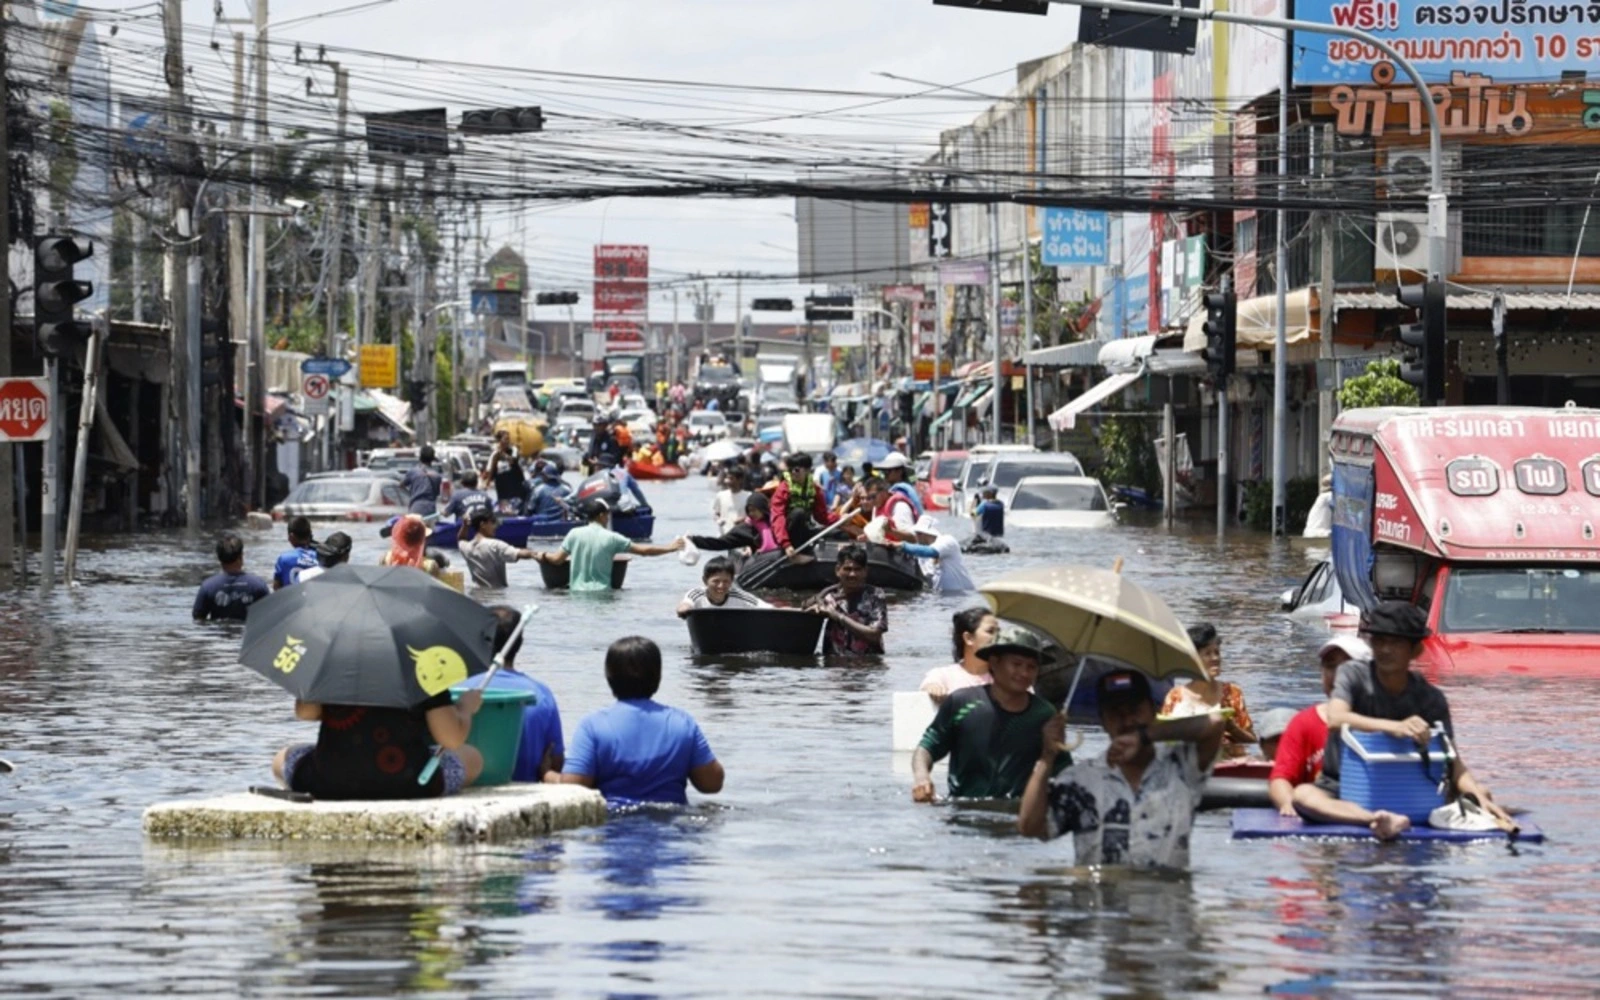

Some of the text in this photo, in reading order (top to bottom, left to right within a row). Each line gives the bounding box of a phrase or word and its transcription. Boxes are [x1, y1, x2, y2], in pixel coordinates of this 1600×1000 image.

[1535, 34, 1566, 58] 10
[1329, 60, 1534, 138] ทำฟัน
[1048, 210, 1102, 231] ทำฟัน
[1047, 235, 1103, 257] จัดฟัน
[1456, 464, 1556, 488] รถ ไฟ
[273, 646, 300, 674] 5G
